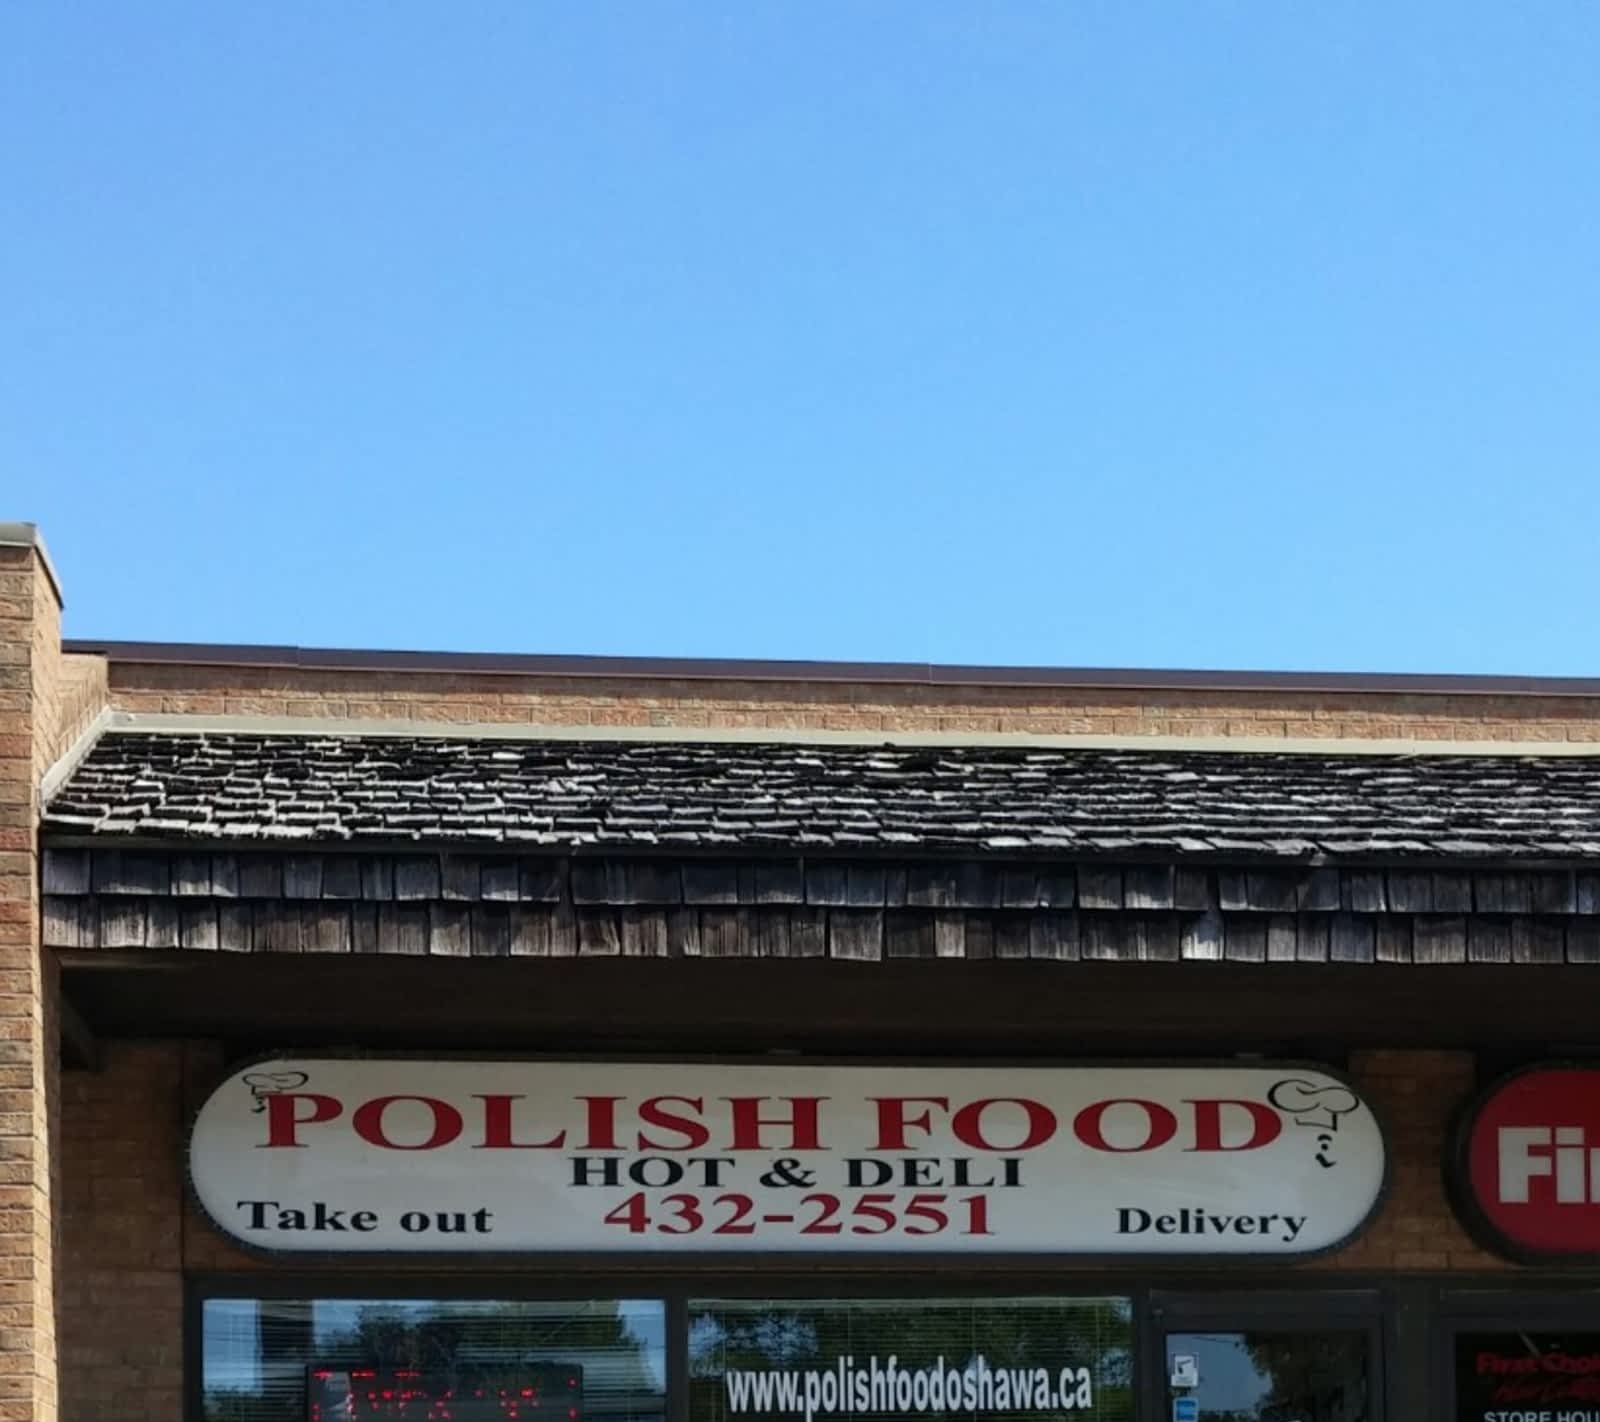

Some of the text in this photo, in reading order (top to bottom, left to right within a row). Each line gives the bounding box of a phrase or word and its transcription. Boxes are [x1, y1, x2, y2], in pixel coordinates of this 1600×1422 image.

[255, 1093, 1283, 1153] POLISH FOOD
[567, 1156, 1025, 1188] HOT & DELI
[236, 1200, 494, 1233] Take out
[603, 1191, 997, 1236] 432-2551
[1115, 1206, 1309, 1243] Delivery
